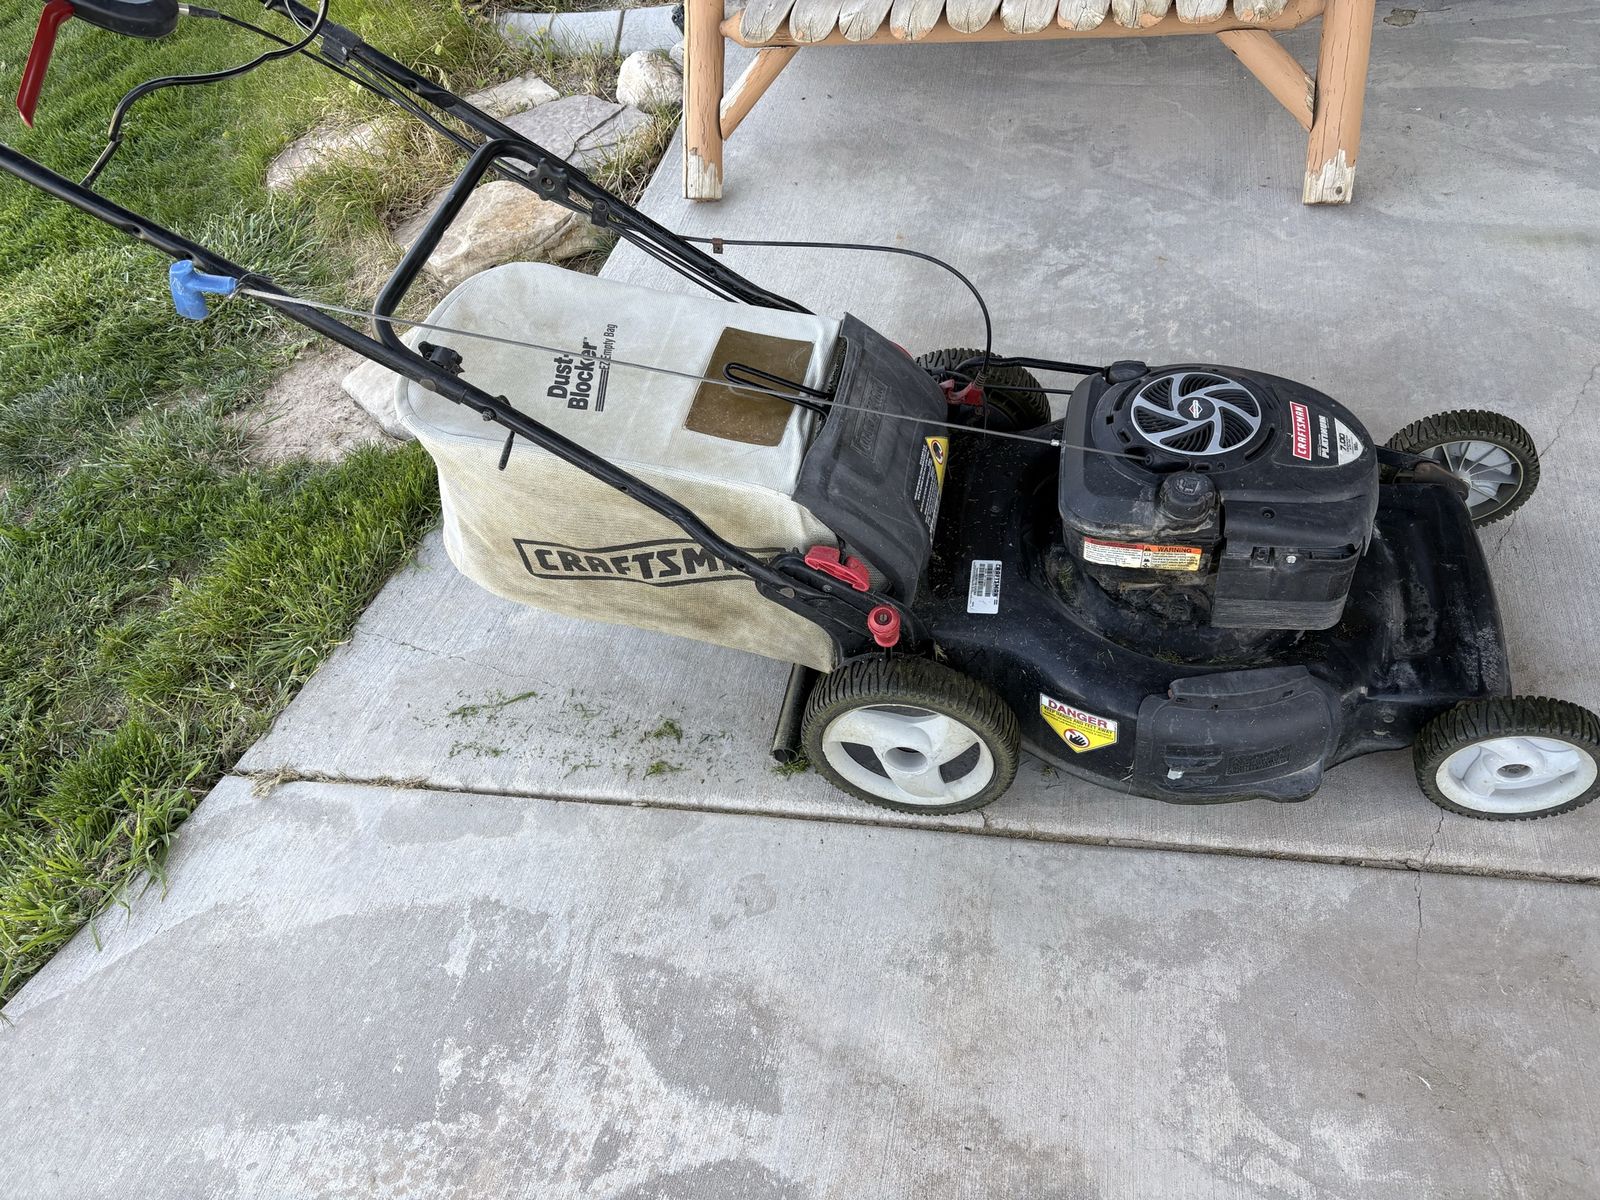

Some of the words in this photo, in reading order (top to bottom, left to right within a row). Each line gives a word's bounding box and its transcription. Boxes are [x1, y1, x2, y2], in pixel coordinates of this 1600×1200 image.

[603, 324, 618, 338] Bag
[1295, 406, 1307, 455] CRAFTSMAN
[1318, 415, 1329, 459] PLATINUM
[1048, 699, 1108, 729] DANGER
